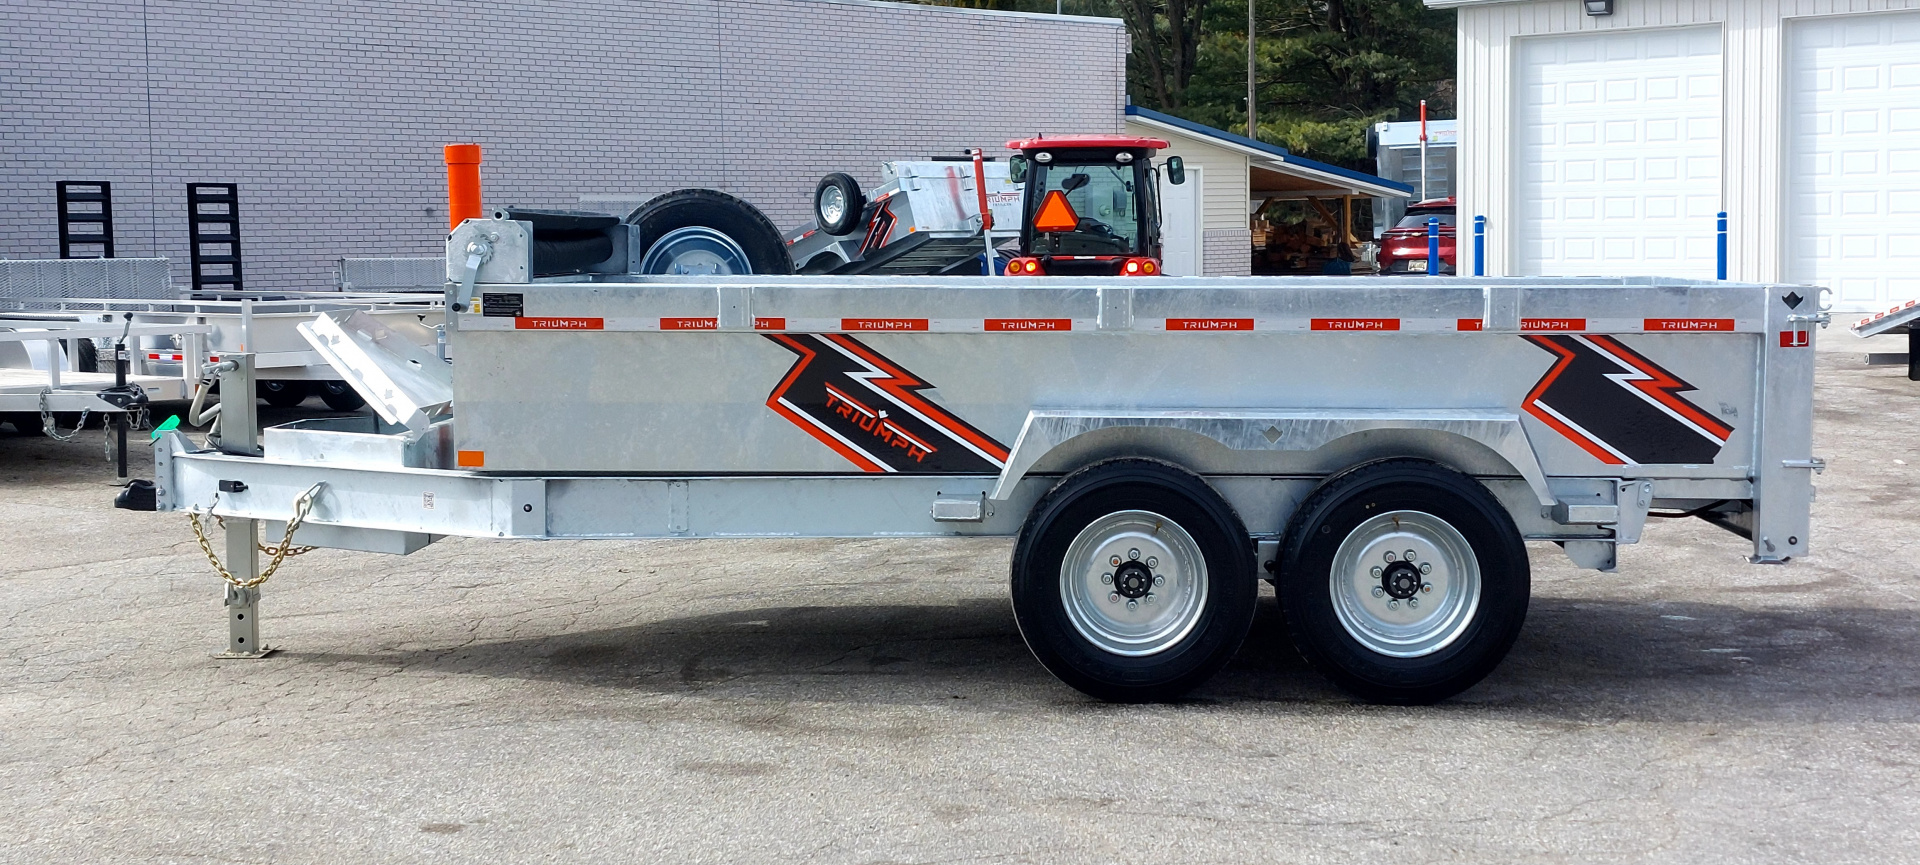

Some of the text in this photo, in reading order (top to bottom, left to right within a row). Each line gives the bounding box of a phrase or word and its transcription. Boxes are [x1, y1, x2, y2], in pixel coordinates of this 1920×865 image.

[986, 195, 1020, 204] RIUMPH
[532, 320, 588, 328] TRIUMPH
[858, 320, 912, 329] TRIUMPH
[1000, 321, 1056, 329] TRIUMPH
[1182, 321, 1238, 329] TRIUMPH
[1327, 321, 1384, 329] TRIUMPH
[1661, 321, 1719, 329] TRIUMPH
[825, 393, 928, 463] TRIUMPH
